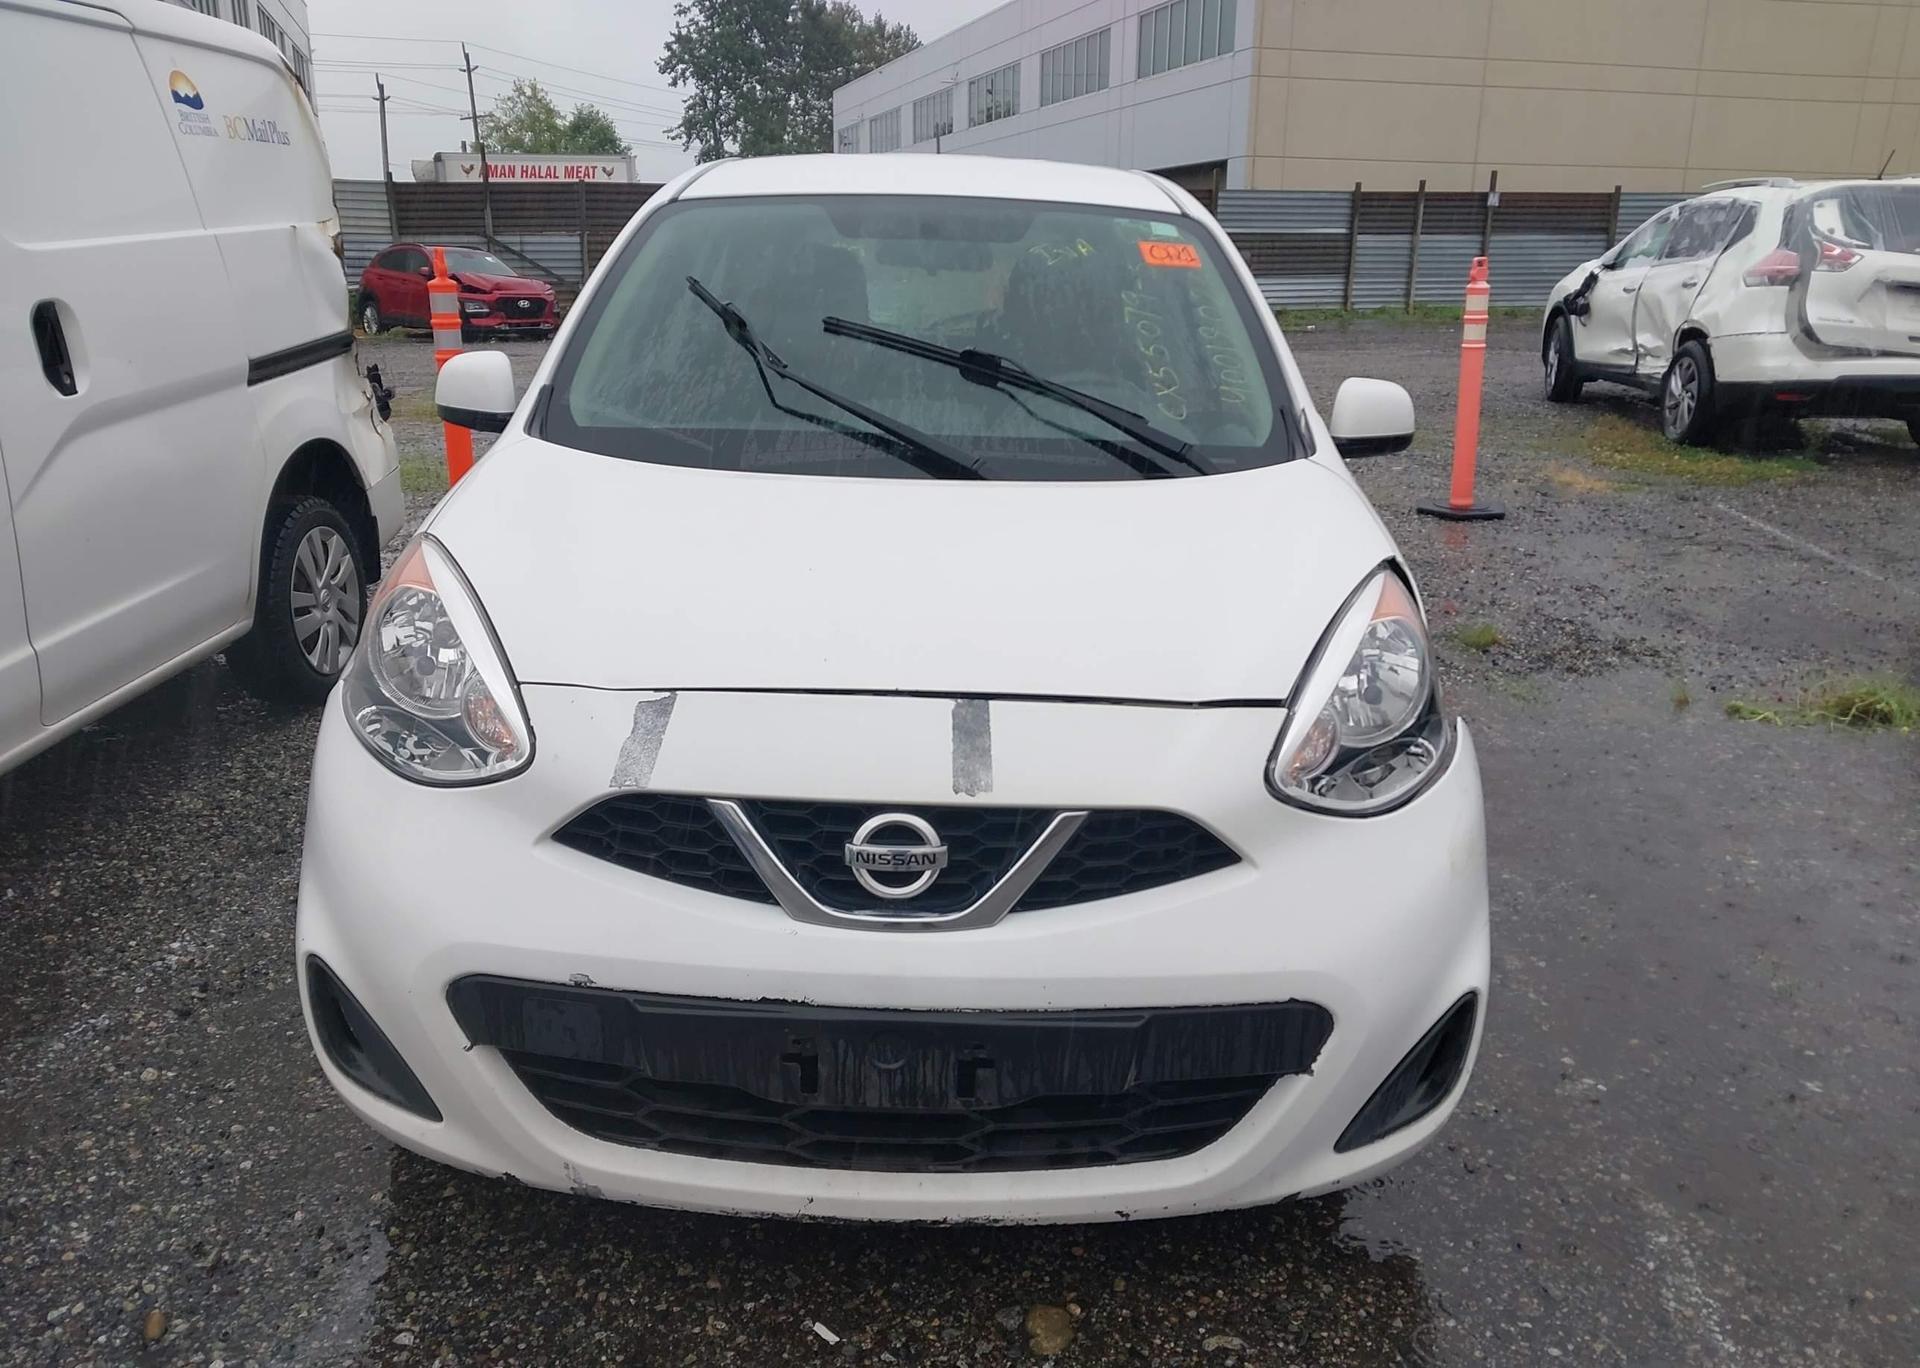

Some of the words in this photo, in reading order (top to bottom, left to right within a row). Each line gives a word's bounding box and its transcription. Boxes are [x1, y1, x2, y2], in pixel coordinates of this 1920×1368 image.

[520, 164, 559, 179] HALAL
[563, 165, 598, 180] MEAT
[856, 852, 937, 866] NISSAN
